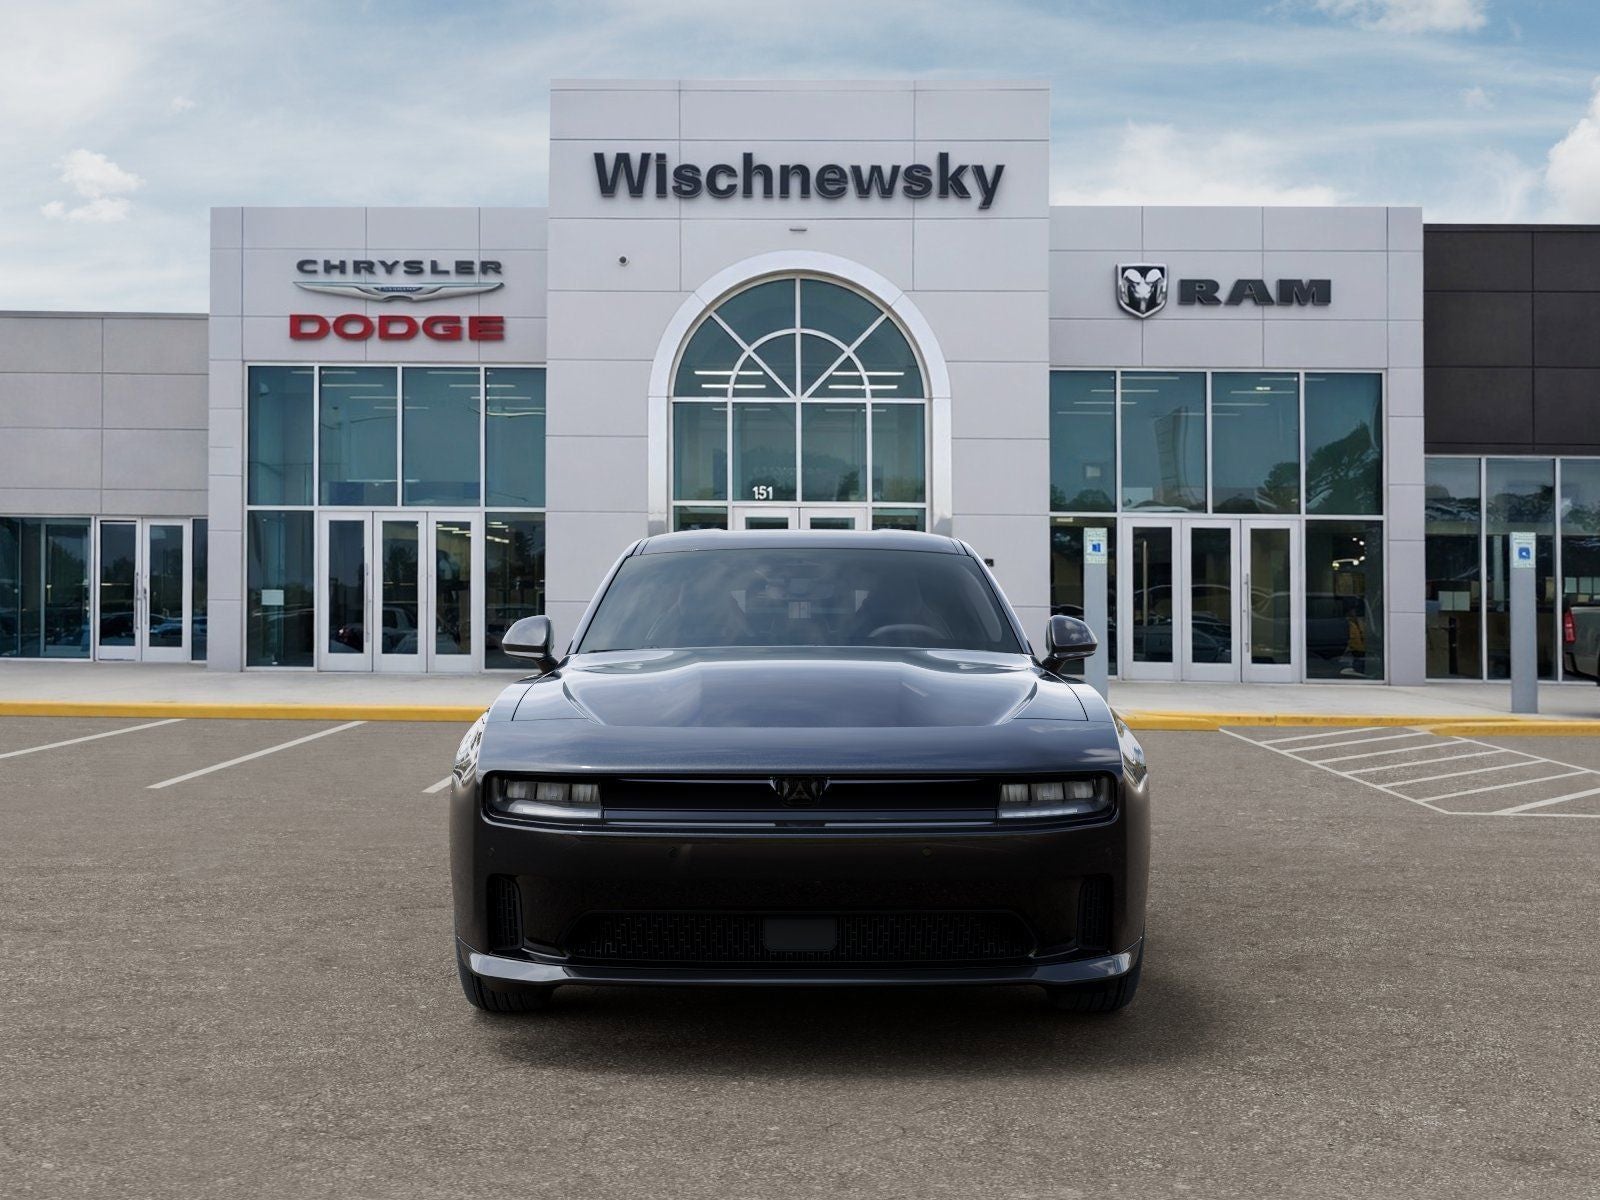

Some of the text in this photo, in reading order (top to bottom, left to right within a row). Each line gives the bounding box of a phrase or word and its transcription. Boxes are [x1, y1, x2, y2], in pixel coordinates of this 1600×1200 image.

[593, 152, 1006, 210] Wischnewsky
[296, 259, 503, 275] CHRYSLER
[1177, 279, 1332, 306] RAM
[289, 314, 505, 341] DODGE
[752, 485, 773, 500] 151
